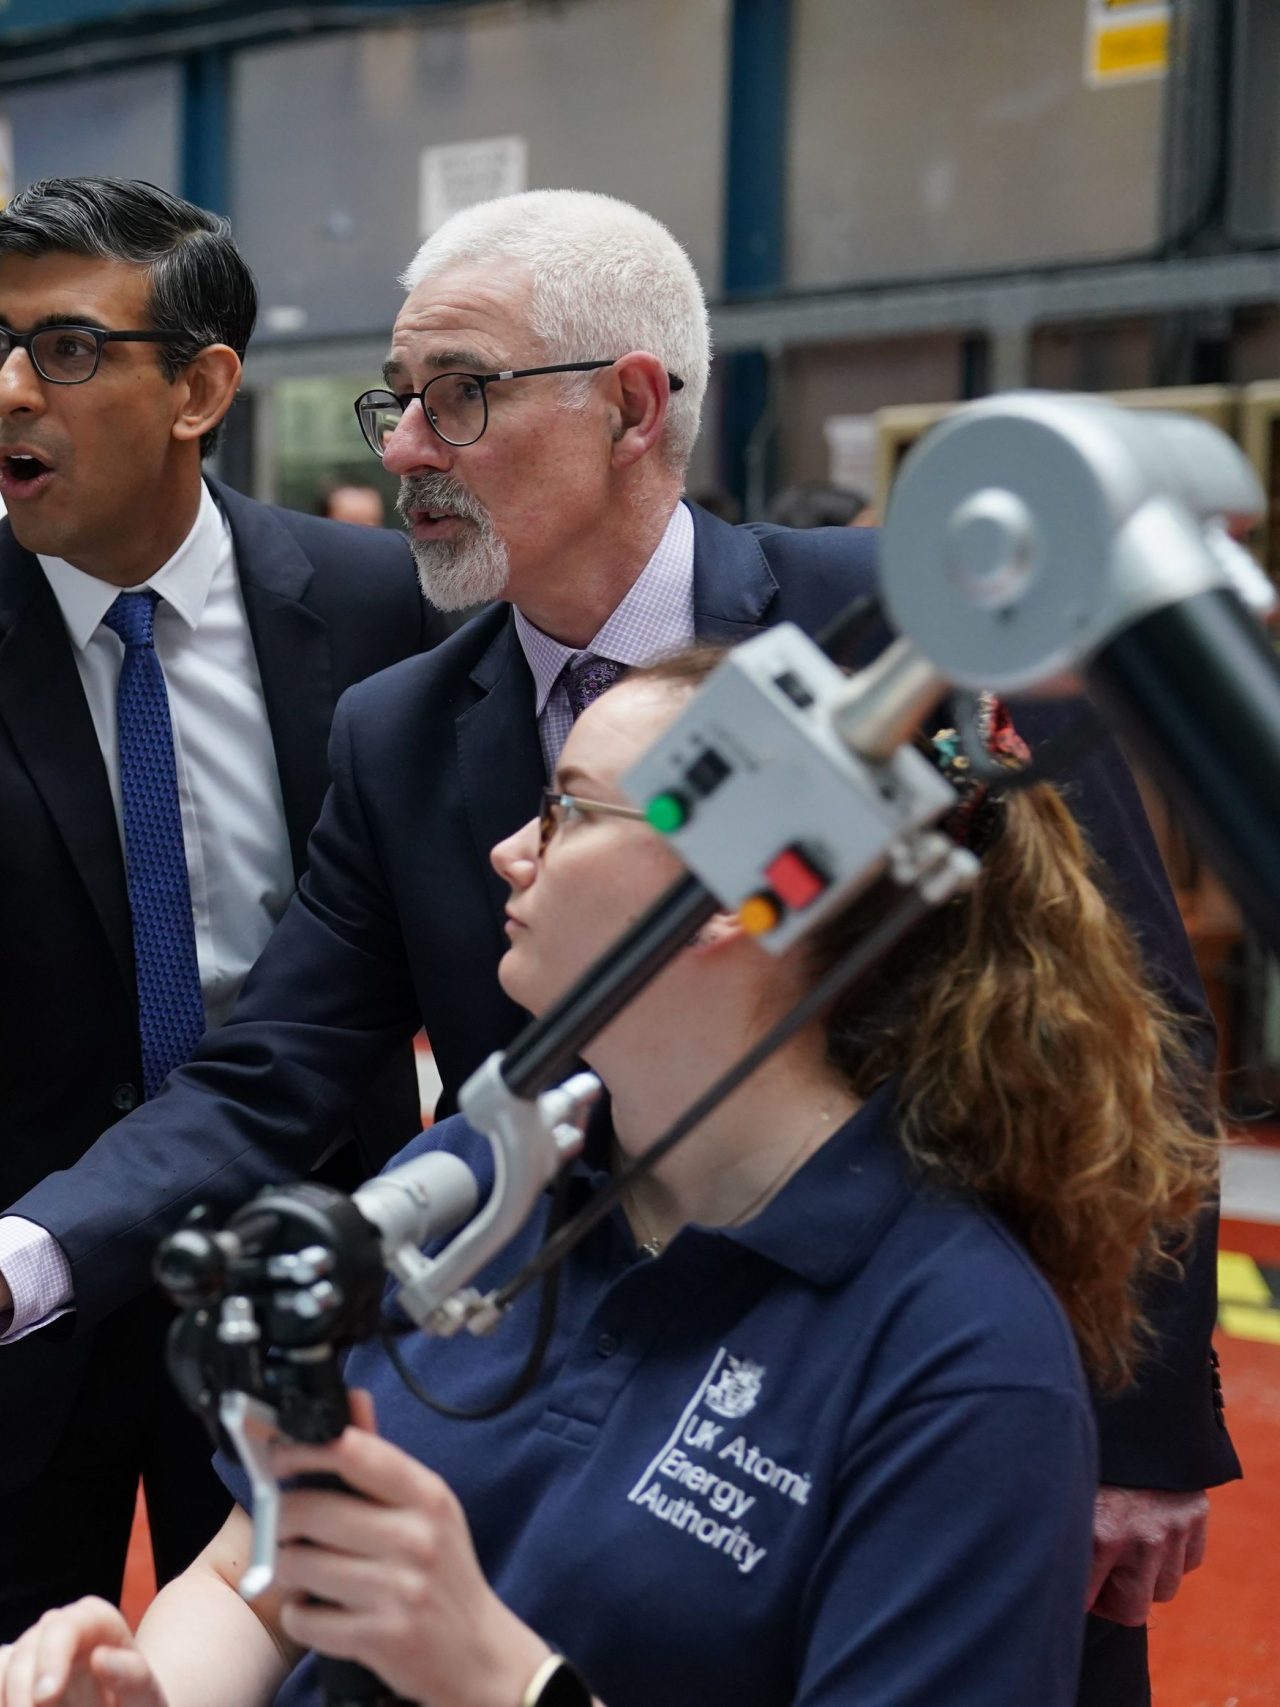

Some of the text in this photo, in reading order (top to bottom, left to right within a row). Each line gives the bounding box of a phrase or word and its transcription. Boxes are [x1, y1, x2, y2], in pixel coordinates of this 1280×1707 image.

[659, 1448, 756, 1519] Energy
[683, 1415, 812, 1505] UK Atomi
[636, 1482, 767, 1573] Authority
